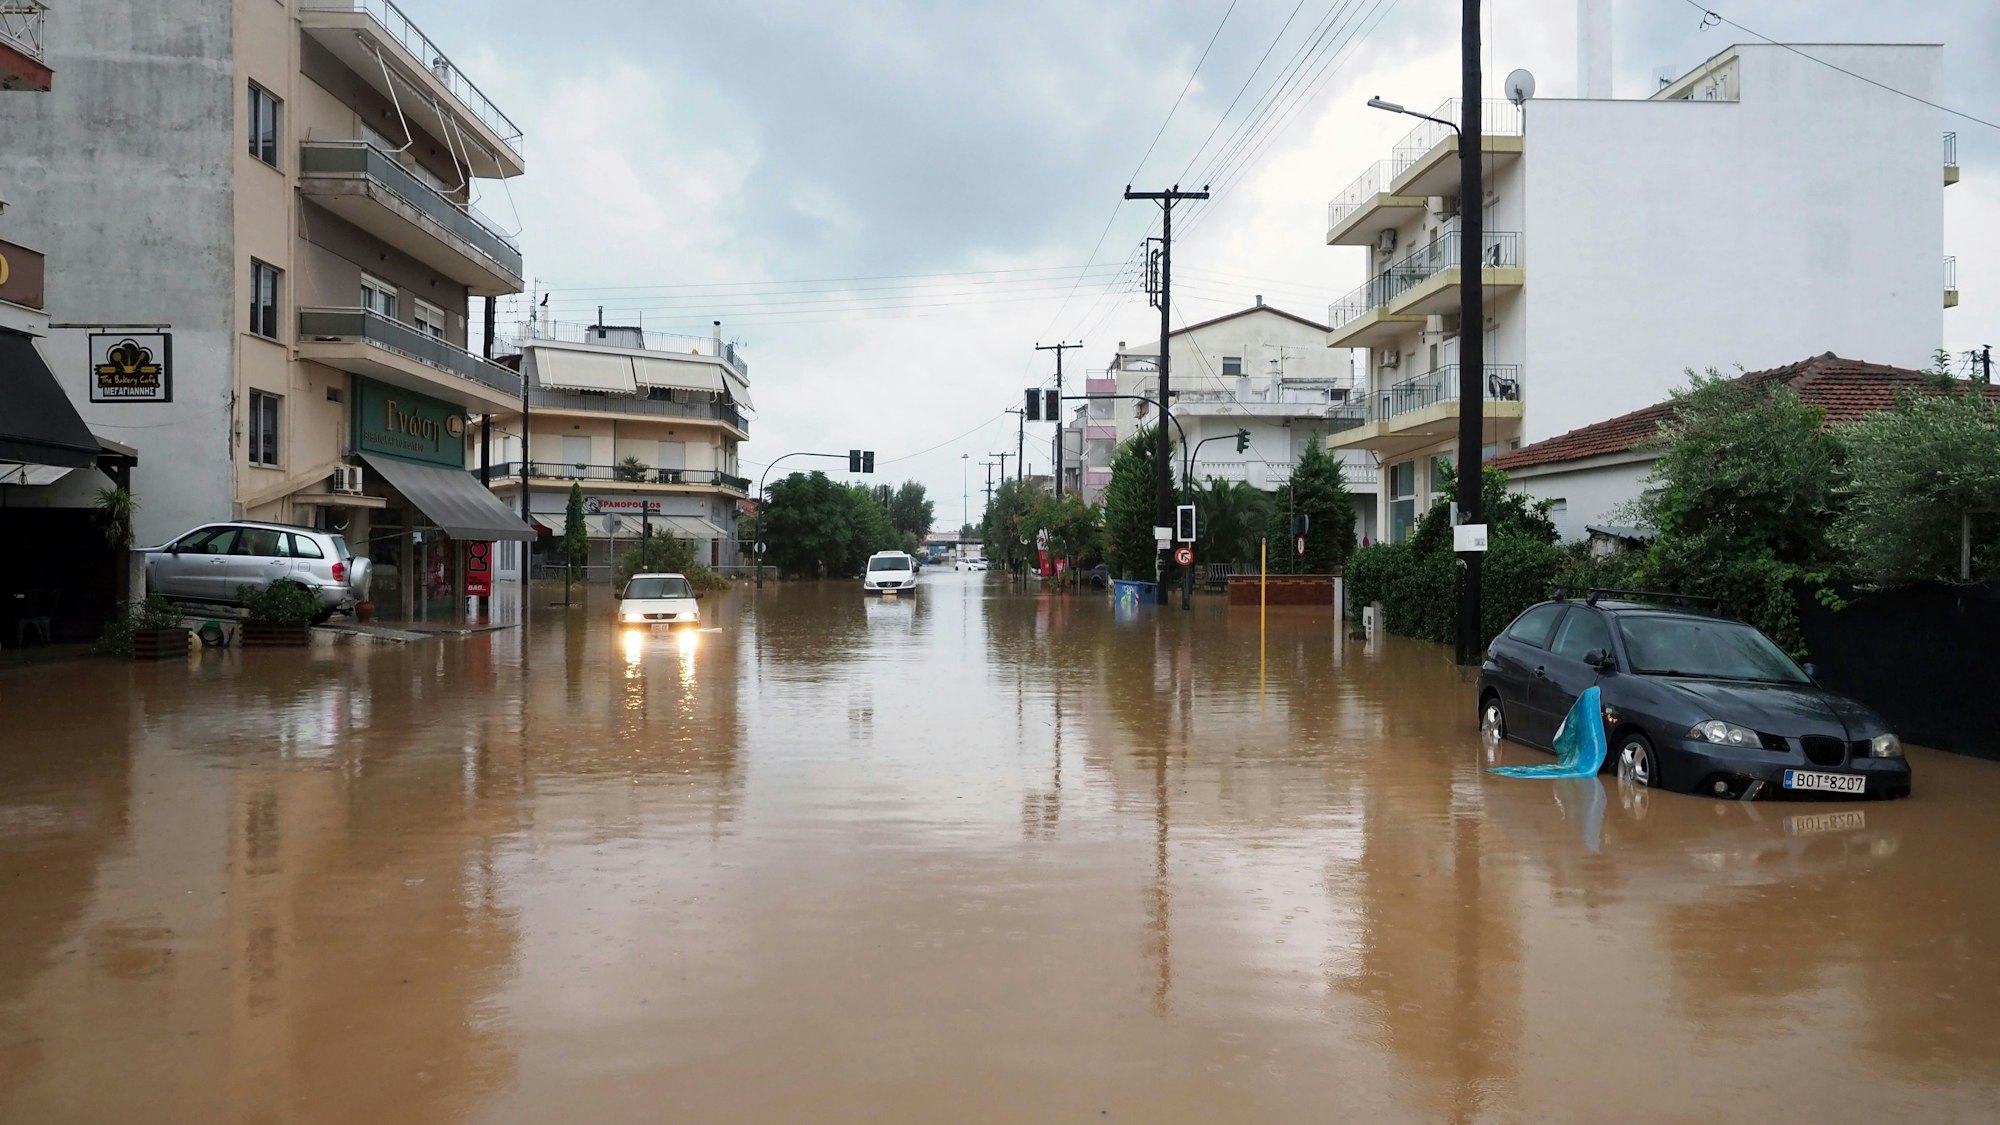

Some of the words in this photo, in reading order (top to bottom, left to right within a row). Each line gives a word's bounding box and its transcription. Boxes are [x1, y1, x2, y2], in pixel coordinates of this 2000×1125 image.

[100, 375, 112, 384] The
[114, 374, 138, 385] Bakery
[103, 387, 155, 396] ΜΕΓΑΓΙΑΝΝΗΣ
[385, 399, 440, 452] Γνώση
[598, 501, 661, 509] SPANOPOUOS
